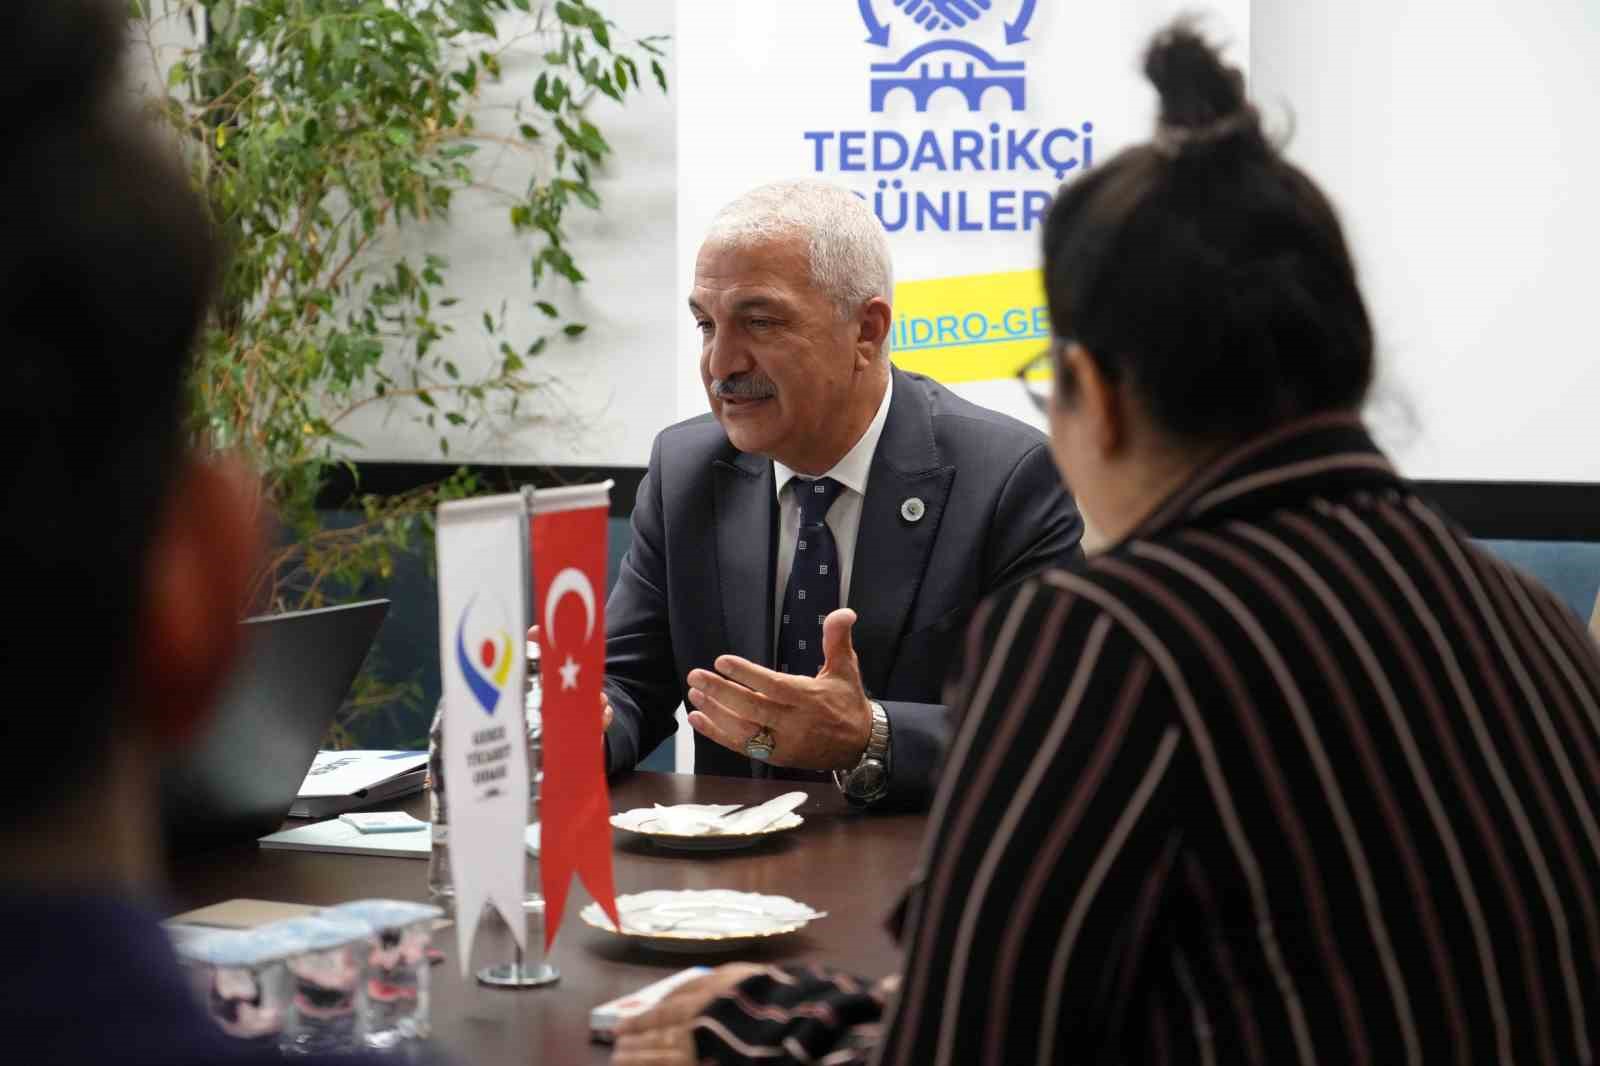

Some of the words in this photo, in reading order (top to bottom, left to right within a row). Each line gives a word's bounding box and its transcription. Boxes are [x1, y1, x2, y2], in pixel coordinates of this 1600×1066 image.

[803, 122, 1093, 180] TEDARİKÇİ
[852, 179, 1048, 232] ÜNLER
[890, 306, 1050, 347] İDRO-GE
